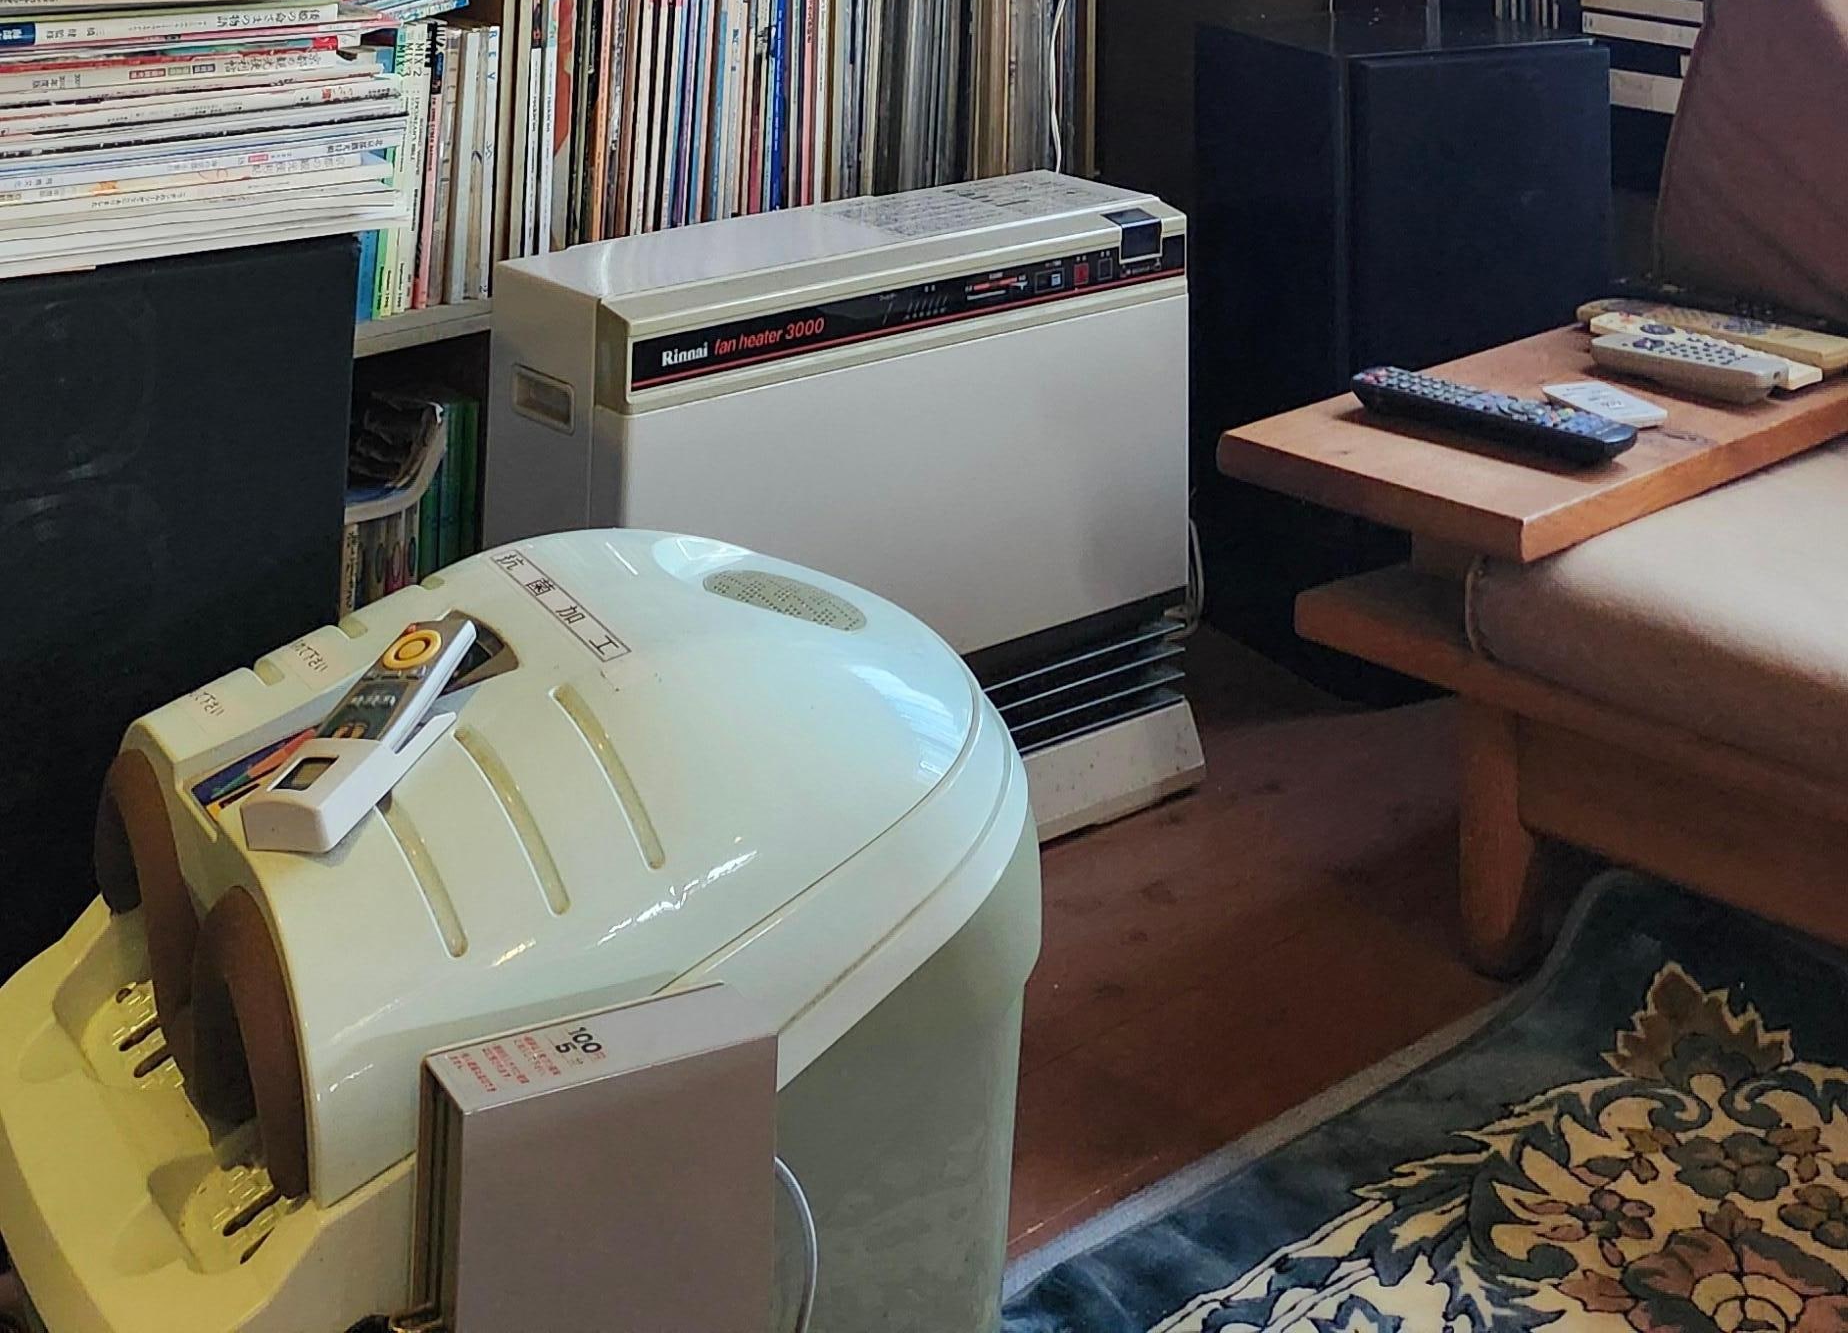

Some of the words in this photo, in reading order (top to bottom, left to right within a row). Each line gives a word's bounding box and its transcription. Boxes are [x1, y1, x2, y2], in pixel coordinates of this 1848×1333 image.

[661, 340, 709, 367] Rinnai
[714, 331, 737, 355] fan
[738, 325, 783, 352] heater
[785, 317, 825, 342] 3000
